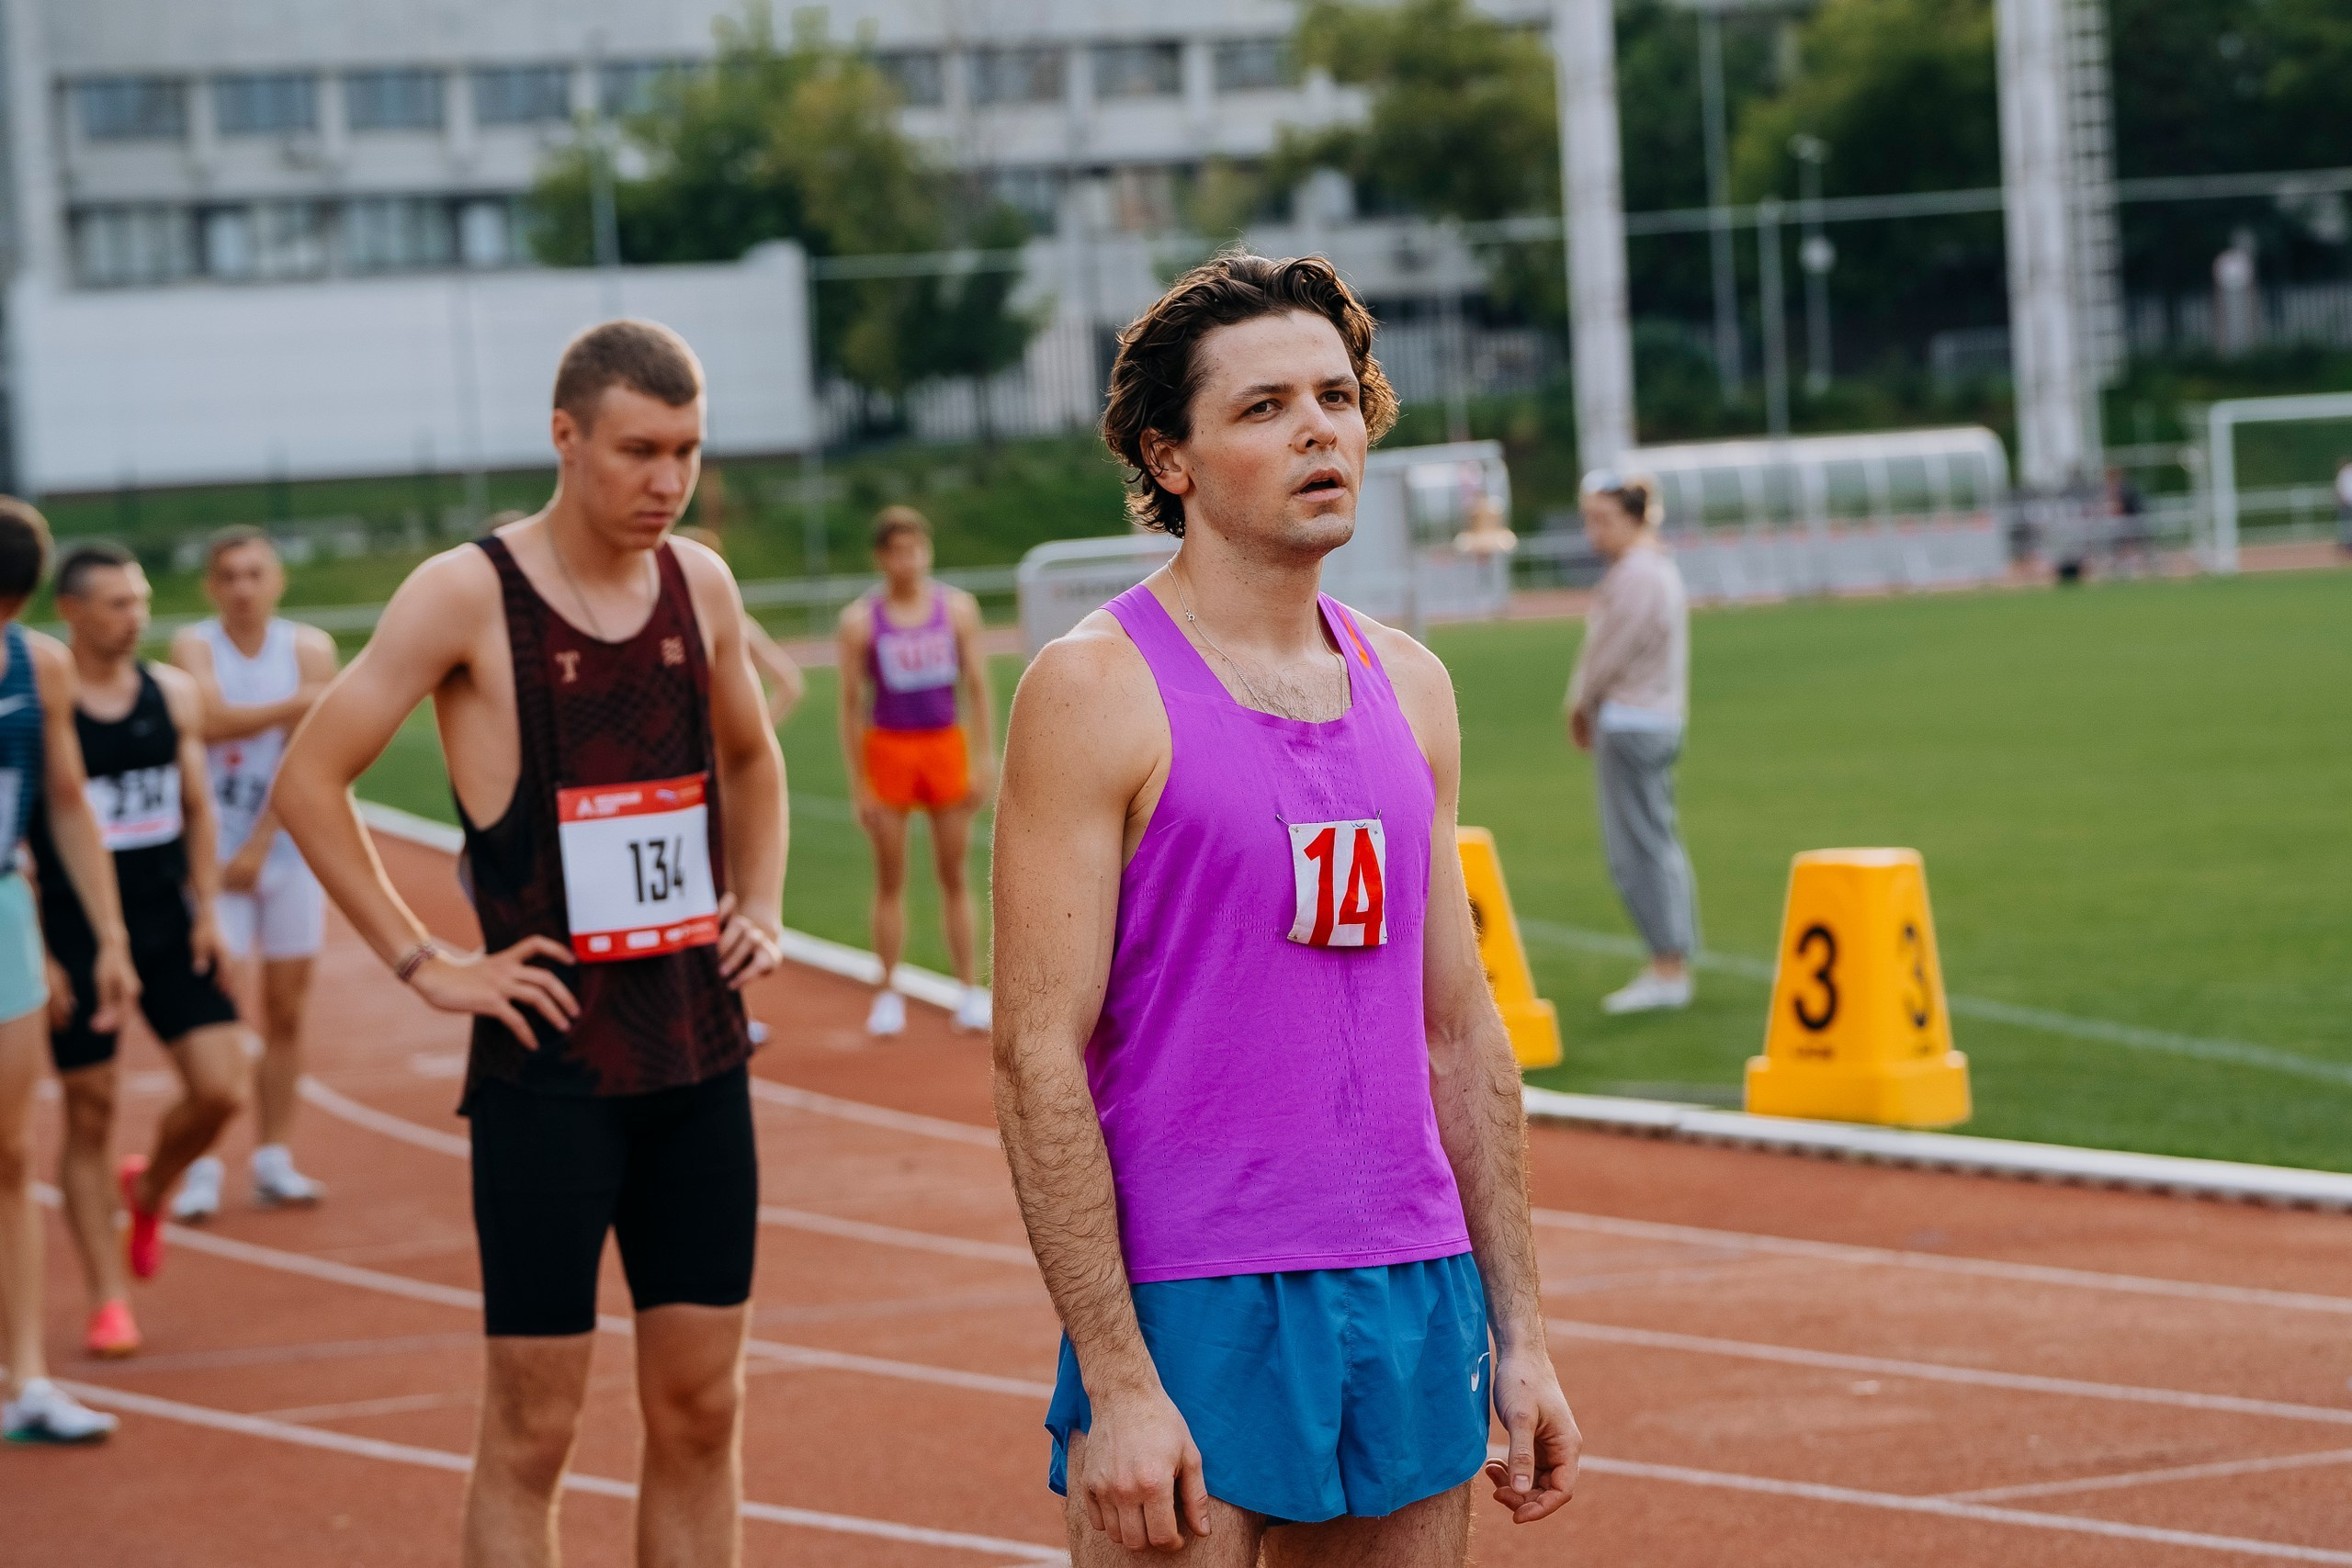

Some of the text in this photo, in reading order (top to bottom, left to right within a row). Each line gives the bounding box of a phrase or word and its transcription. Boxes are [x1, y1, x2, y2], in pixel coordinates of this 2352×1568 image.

[628, 836, 686, 904] 134
[1303, 827, 1384, 946] 14
[1793, 924, 1838, 1031] 3
[1899, 921, 1932, 1029] 3
